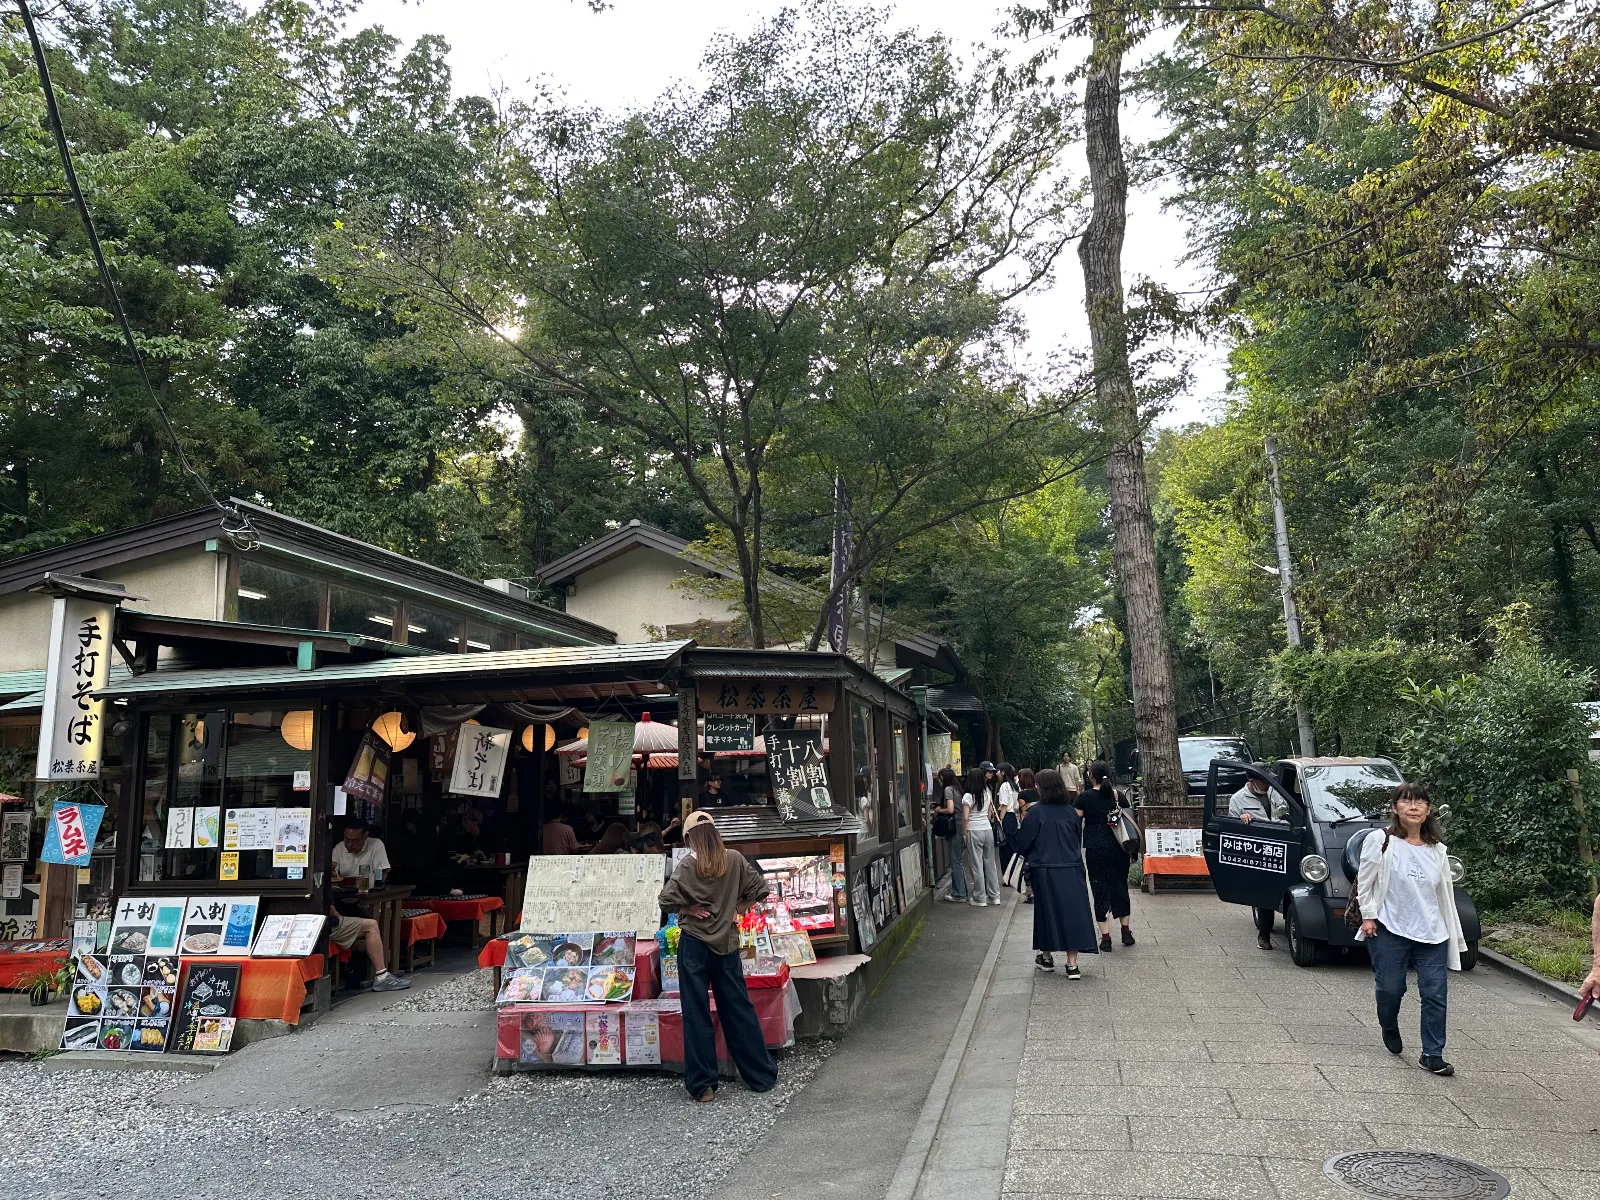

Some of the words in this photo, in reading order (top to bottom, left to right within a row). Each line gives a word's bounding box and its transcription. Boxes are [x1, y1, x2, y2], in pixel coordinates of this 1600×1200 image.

[67, 616, 102, 745] 手打そば
[706, 723, 752, 732] クレジットカード
[706, 735, 740, 744] 電子マネー
[52, 758, 98, 776] 松葉茶屋
[782, 739, 808, 790] 十割
[803, 739, 828, 787] 八割
[344, 776, 384, 802] 冷えてます
[767, 734, 798, 821] 手打ち蕎麦
[58, 807, 86, 856] ラムネ
[174, 809, 187, 848] うどん
[1223, 839, 1284, 858] みはやし酒店
[120, 902, 156, 921] 十割
[190, 902, 226, 922] 八割
